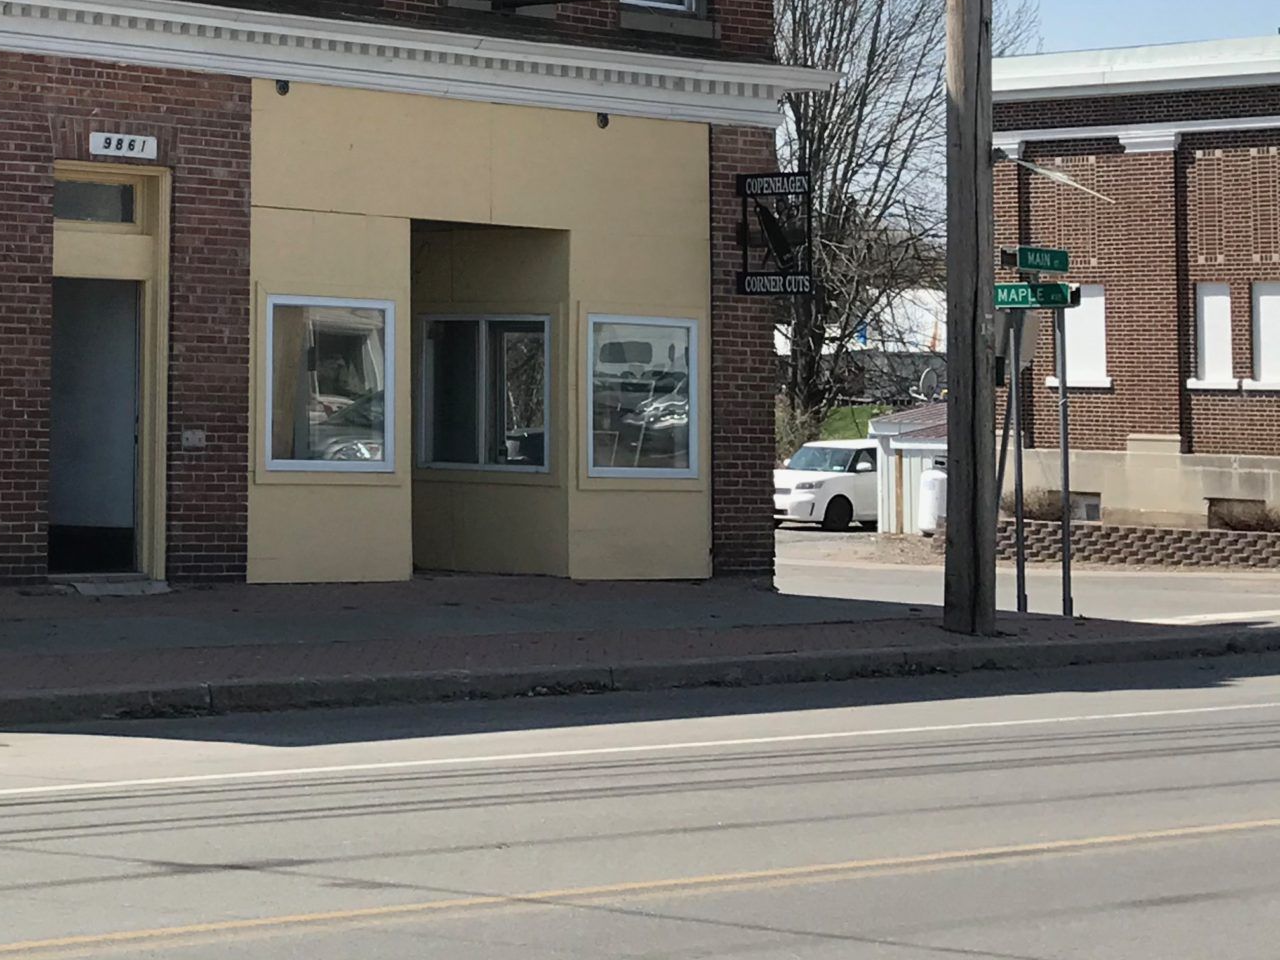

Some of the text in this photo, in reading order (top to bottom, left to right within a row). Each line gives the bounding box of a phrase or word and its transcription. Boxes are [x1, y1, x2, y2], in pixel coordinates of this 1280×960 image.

[103, 137, 146, 152] 9861
[745, 176, 808, 194] COPENHAGEN
[1027, 251, 1050, 266] MAIN
[745, 276, 810, 292] CORNER CUTS
[998, 288, 1044, 302] MAPLE
